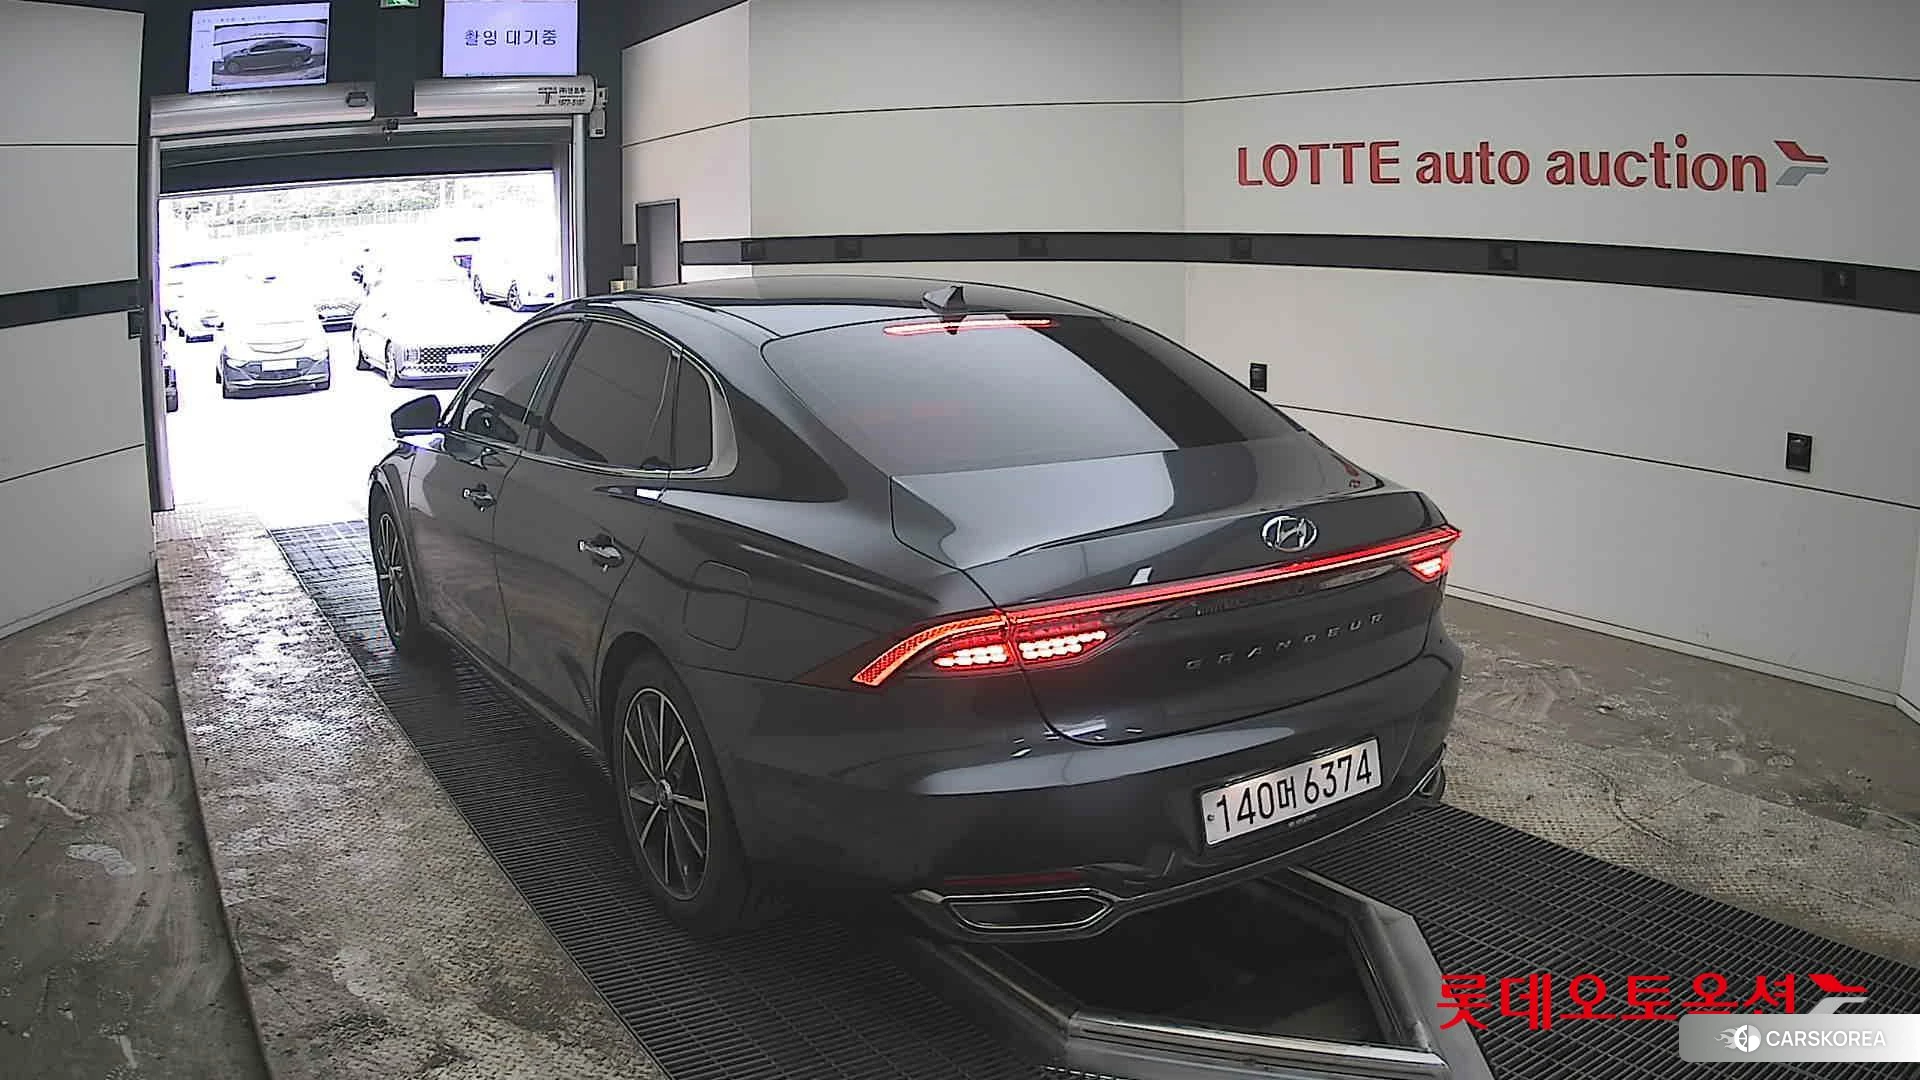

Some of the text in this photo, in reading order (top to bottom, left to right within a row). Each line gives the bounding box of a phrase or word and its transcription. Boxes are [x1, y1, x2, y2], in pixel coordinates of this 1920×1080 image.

[505, 29, 558, 46] 대기중
[1238, 133, 1768, 194] LOTTE auto auction
[1185, 613, 1384, 670] GRANDEUR
[1216, 748, 1373, 833] 140머 6374
